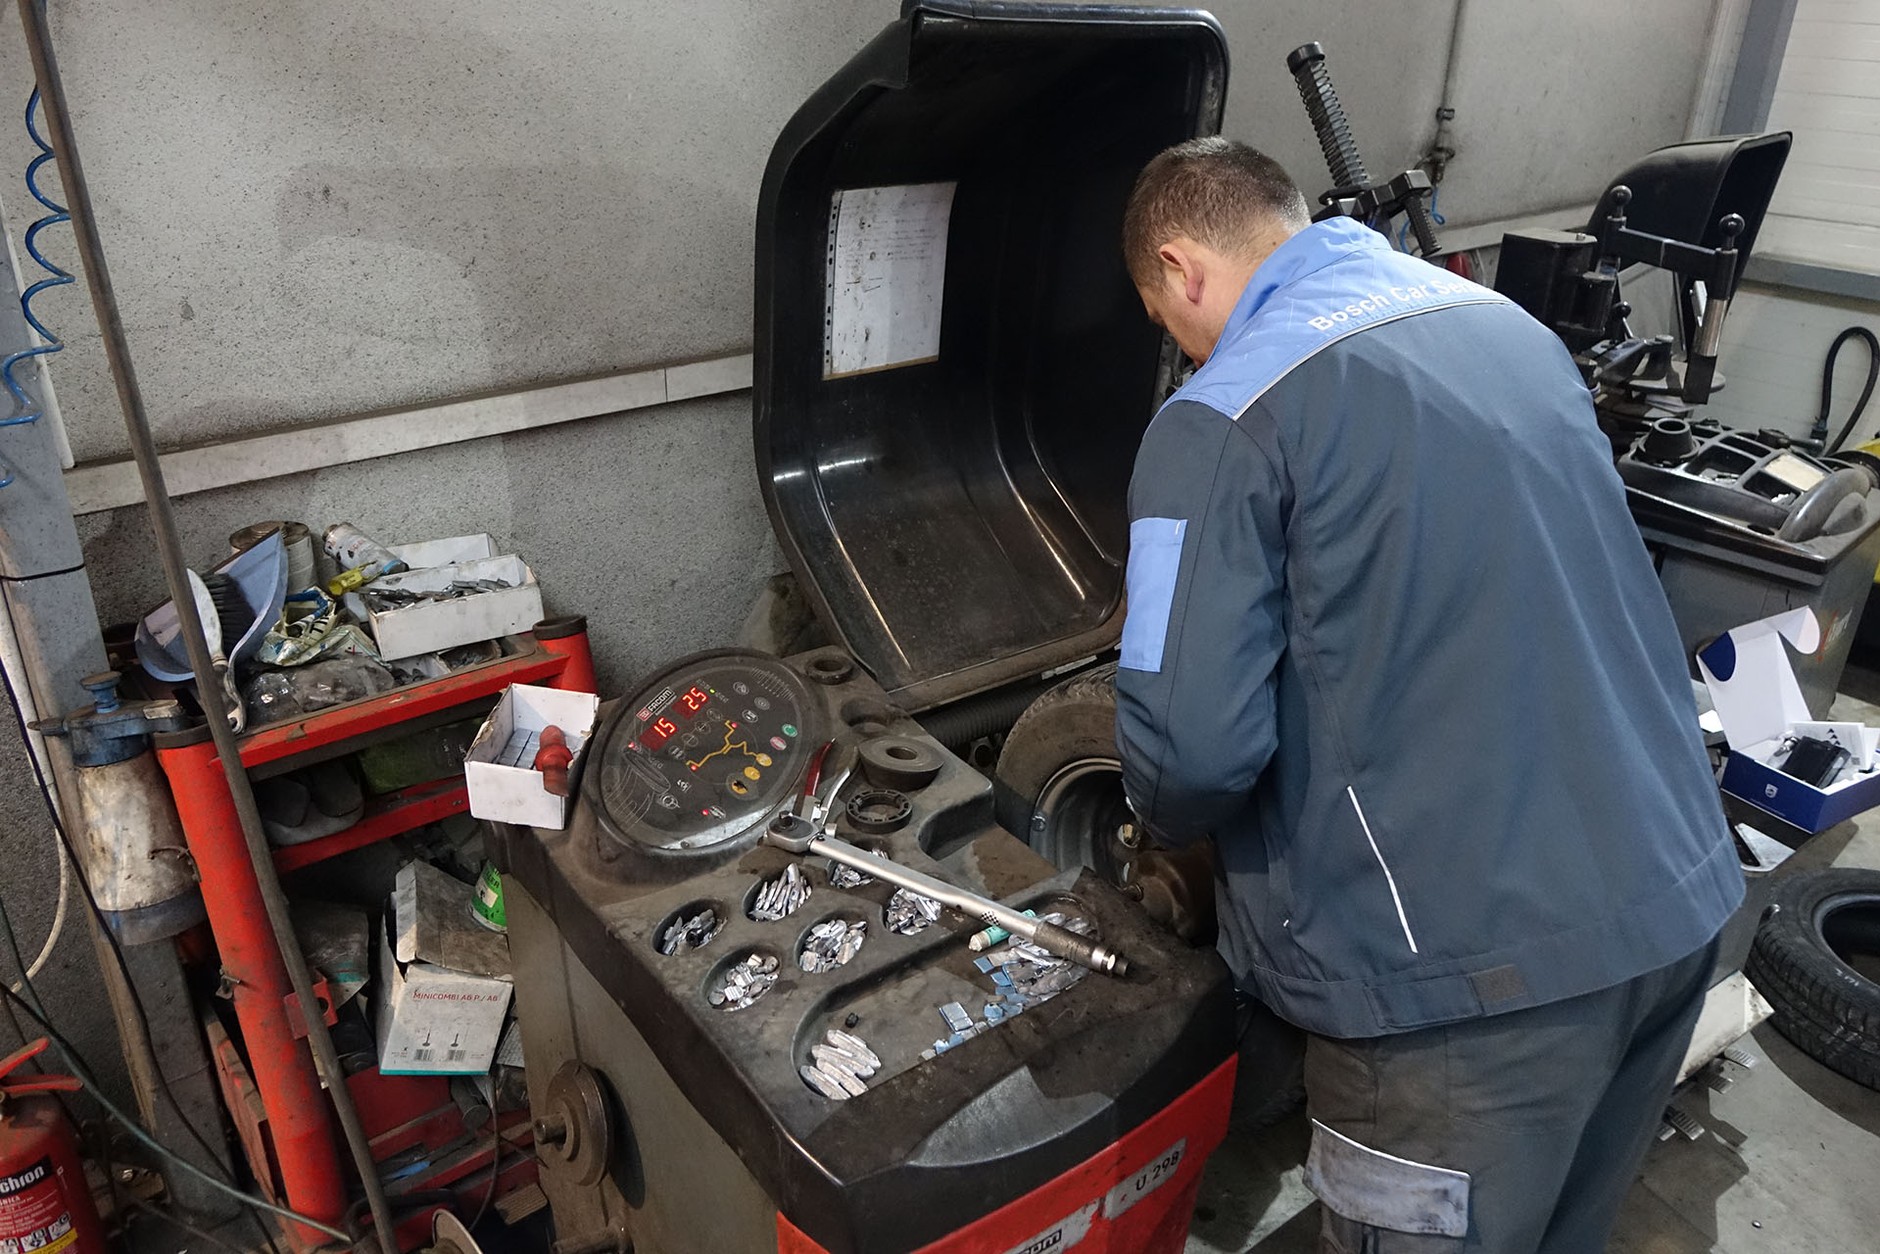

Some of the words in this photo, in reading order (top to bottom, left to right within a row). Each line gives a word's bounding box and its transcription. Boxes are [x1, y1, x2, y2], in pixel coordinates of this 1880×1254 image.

[1307, 293, 1391, 332] Bosch
[1390, 282, 1431, 302] Car
[682, 686, 707, 711] 25
[653, 717, 677, 738] 15
[412, 991, 460, 1001] MINICOMBI
